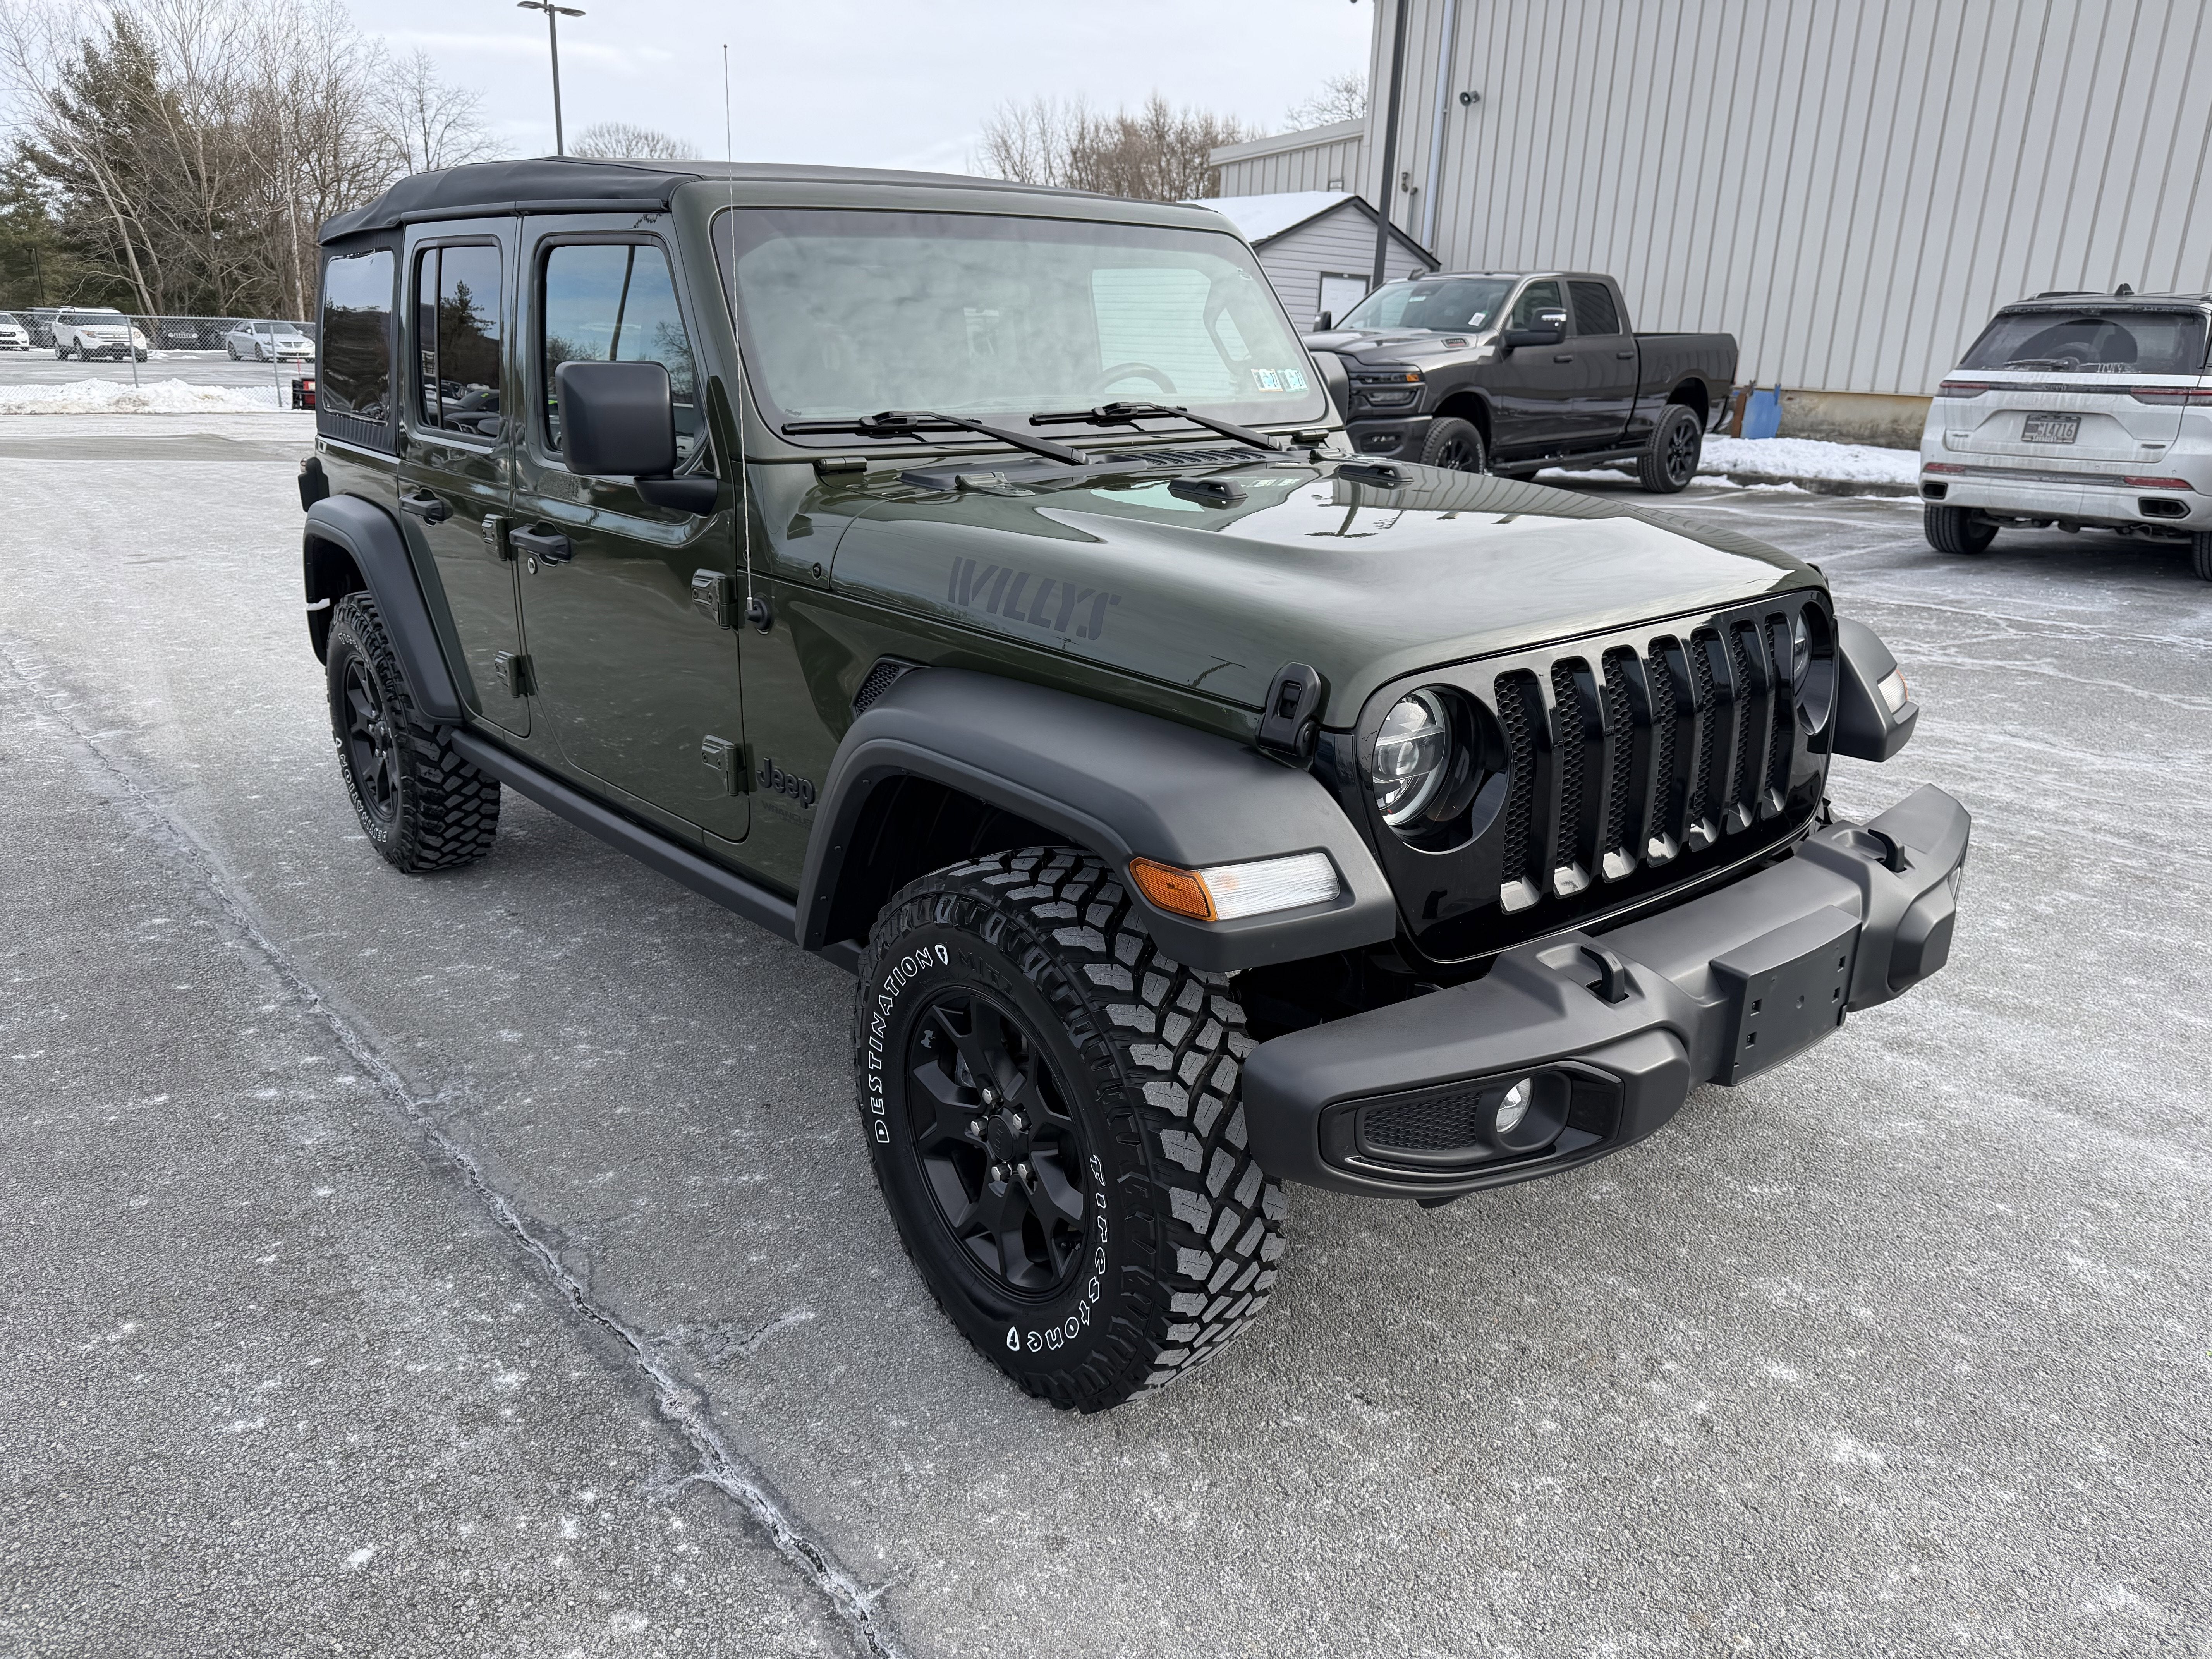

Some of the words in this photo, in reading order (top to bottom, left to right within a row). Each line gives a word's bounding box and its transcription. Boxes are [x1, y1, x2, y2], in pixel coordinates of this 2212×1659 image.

[948, 556, 1122, 641] WILLYS
[340, 754, 387, 843] DESTINATION
[756, 757, 816, 809] Jeep
[868, 946, 933, 1143] DESTINATION
[1027, 1154, 1108, 1352] Firestone
